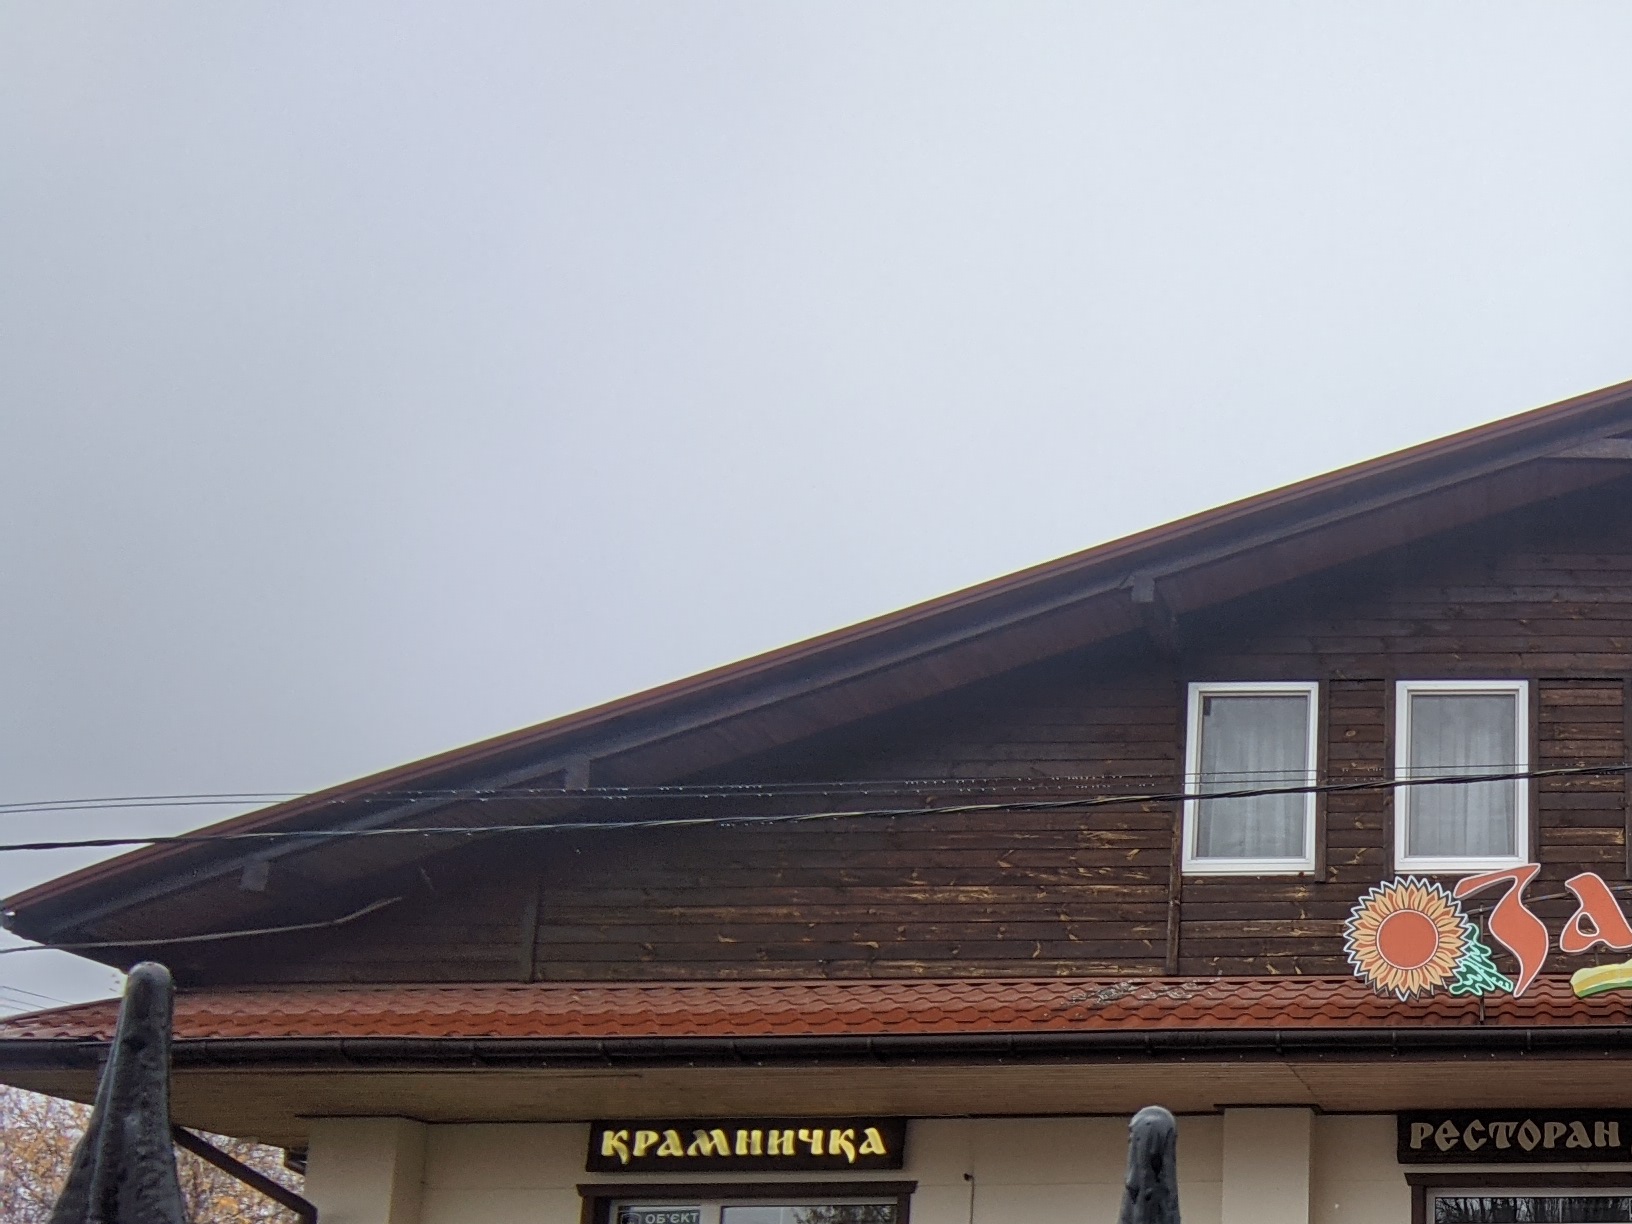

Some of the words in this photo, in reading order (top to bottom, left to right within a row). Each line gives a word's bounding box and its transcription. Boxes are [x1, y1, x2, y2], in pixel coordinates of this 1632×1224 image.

[601, 1127, 887, 1165] КРАМНИЧКА
[1409, 1117, 1620, 1151] РЕСТОРАН
[644, 1212, 699, 1224] ОБ'ЄКТ
